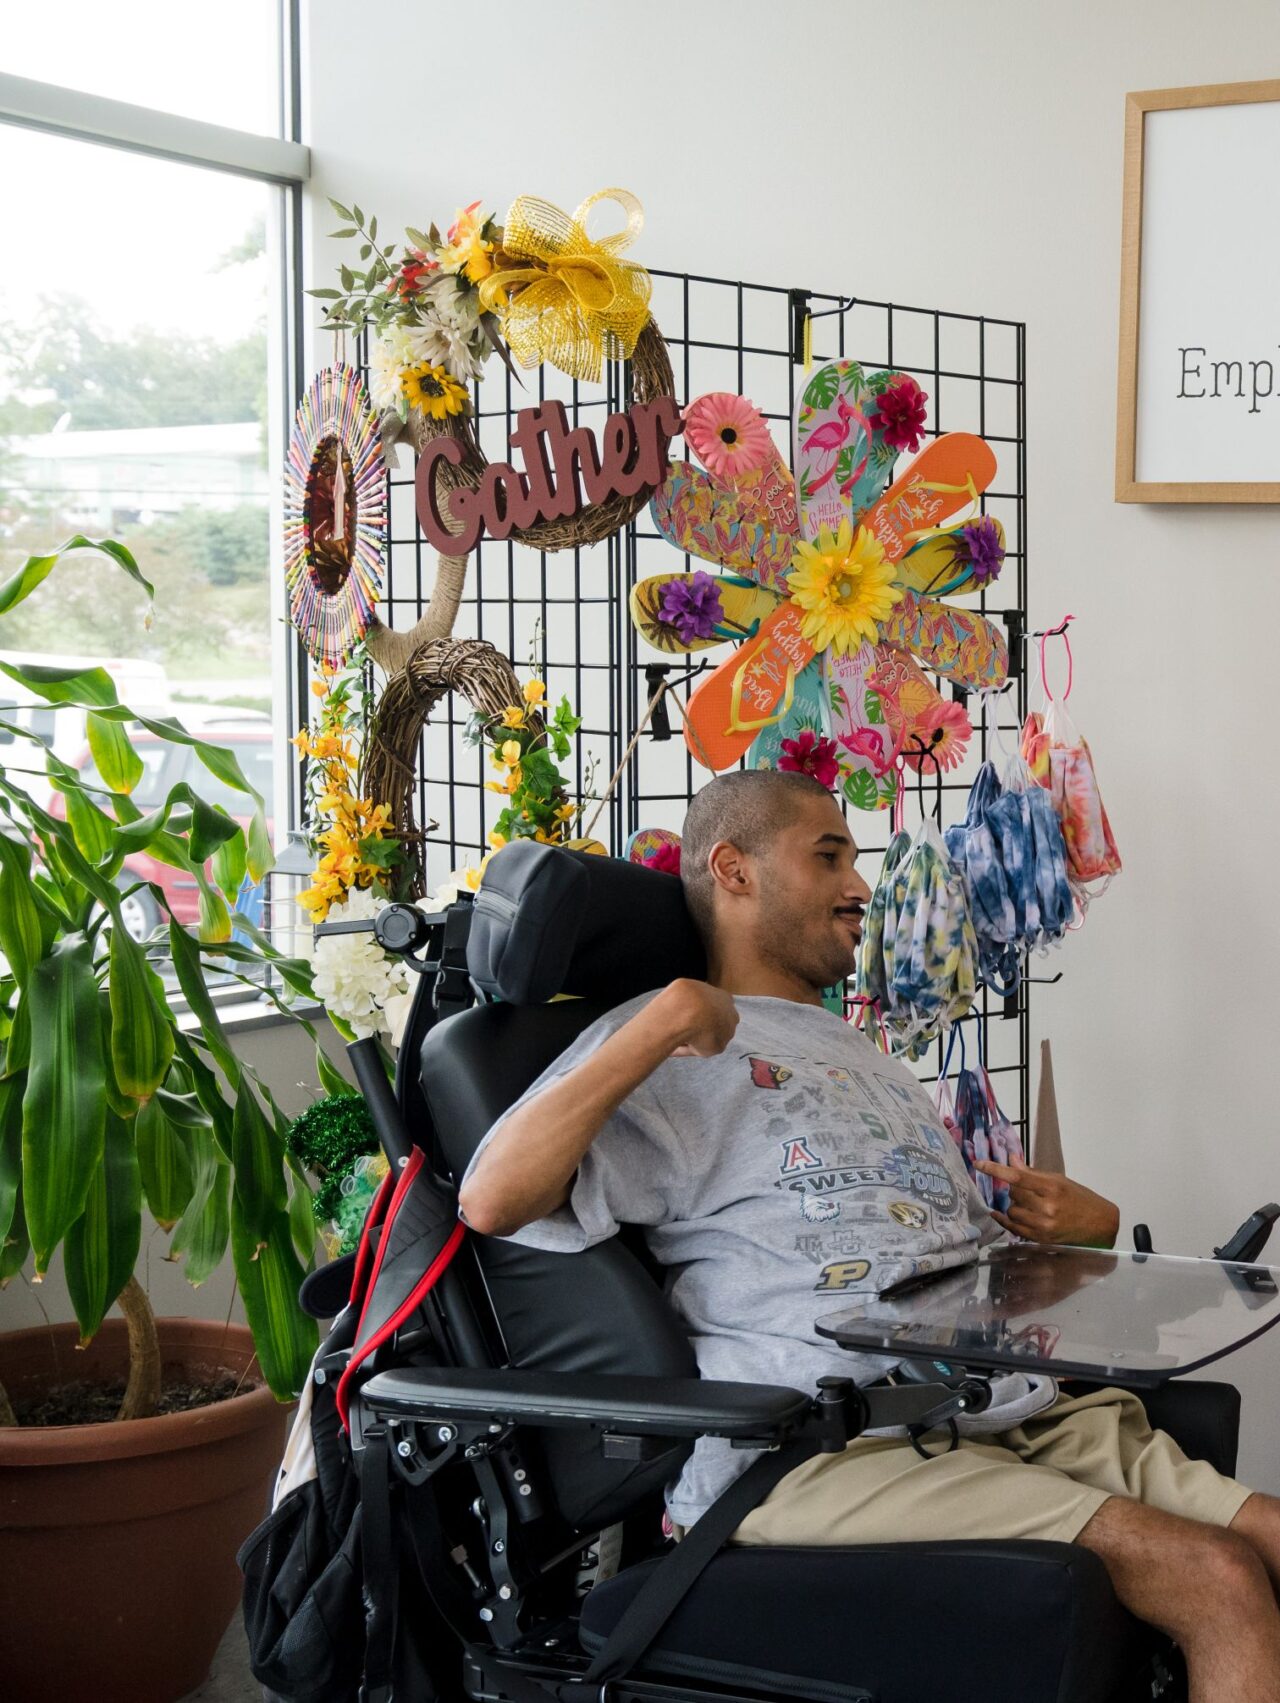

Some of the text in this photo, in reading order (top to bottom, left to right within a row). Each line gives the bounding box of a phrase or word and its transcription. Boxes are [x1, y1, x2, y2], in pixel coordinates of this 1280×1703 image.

[415, 396, 686, 556] Gather
[817, 502, 842, 516] HELLO
[874, 503, 904, 558] happy
[772, 620, 806, 676] happy
[732, 673, 773, 712] Beac
[779, 1135, 823, 1175] A
[788, 1169, 886, 1194] SWEET
[814, 1259, 872, 1290] P
